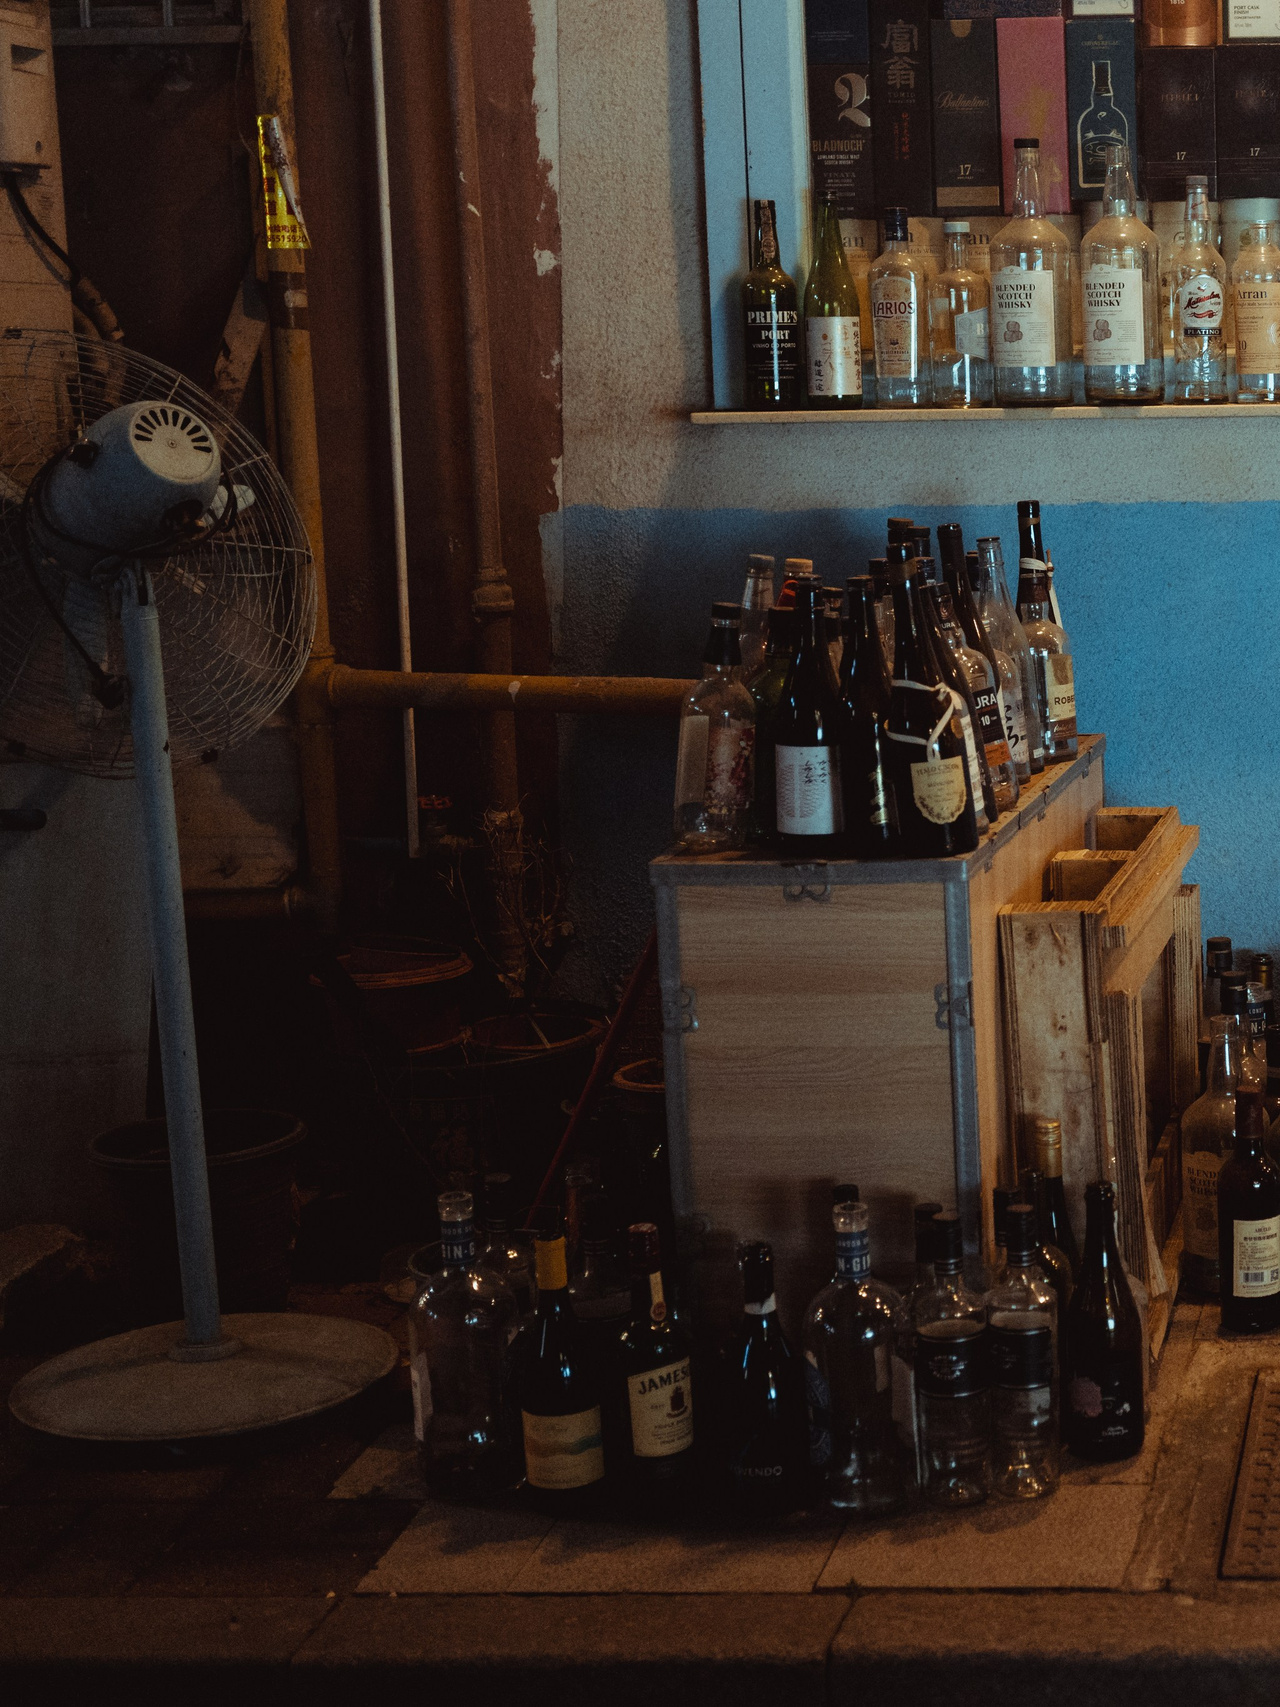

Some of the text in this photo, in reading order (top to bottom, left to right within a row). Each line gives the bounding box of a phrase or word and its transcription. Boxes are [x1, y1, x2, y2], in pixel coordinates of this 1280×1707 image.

[812, 140, 864, 152] BLADNOCH
[1175, 151, 1187, 161] 17
[1250, 147, 1261, 157] 17
[959, 164, 973, 176] 17
[995, 283, 1036, 292] BLENDED
[1085, 281, 1126, 291] BLENDED
[997, 292, 1033, 301] SCOTCH
[1087, 290, 1122, 299] SCOTCH
[1236, 289, 1268, 300] Arran
[998, 301, 1033, 309] WHISKY
[1087, 299, 1122, 308] WHISKY
[873, 301, 915, 319] LARIOS
[760, 329, 791, 340] PORT
[1187, 328, 1221, 337] PLATINO
[1236, 340, 1247, 351] 10
[975, 693, 998, 710] URA
[980, 716, 991, 727] 10
[1187, 1167, 1220, 1180] BLEND
